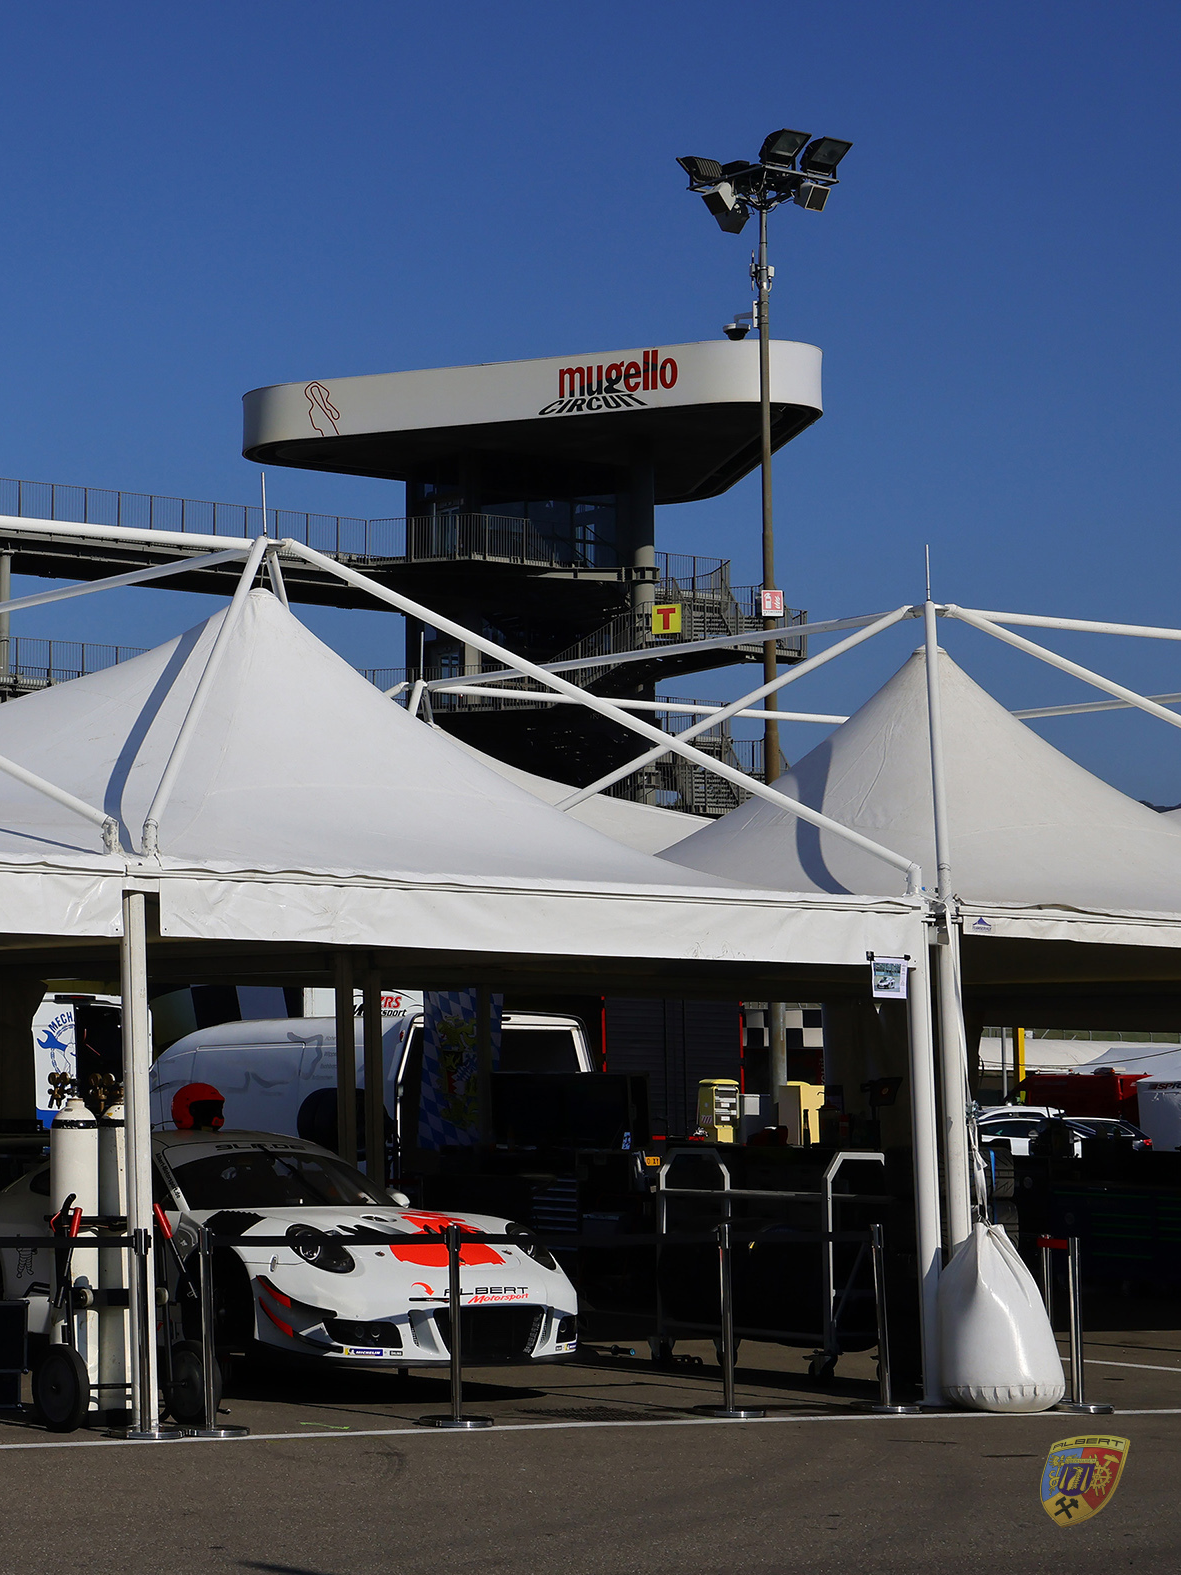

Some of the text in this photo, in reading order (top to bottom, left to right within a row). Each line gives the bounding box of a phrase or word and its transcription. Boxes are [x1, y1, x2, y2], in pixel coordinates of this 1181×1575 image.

[559, 349, 678, 399] mugello
[538, 393, 648, 415] CIRCUIT
[657, 607, 676, 630] T
[467, 1293, 529, 1304] Motorsport
